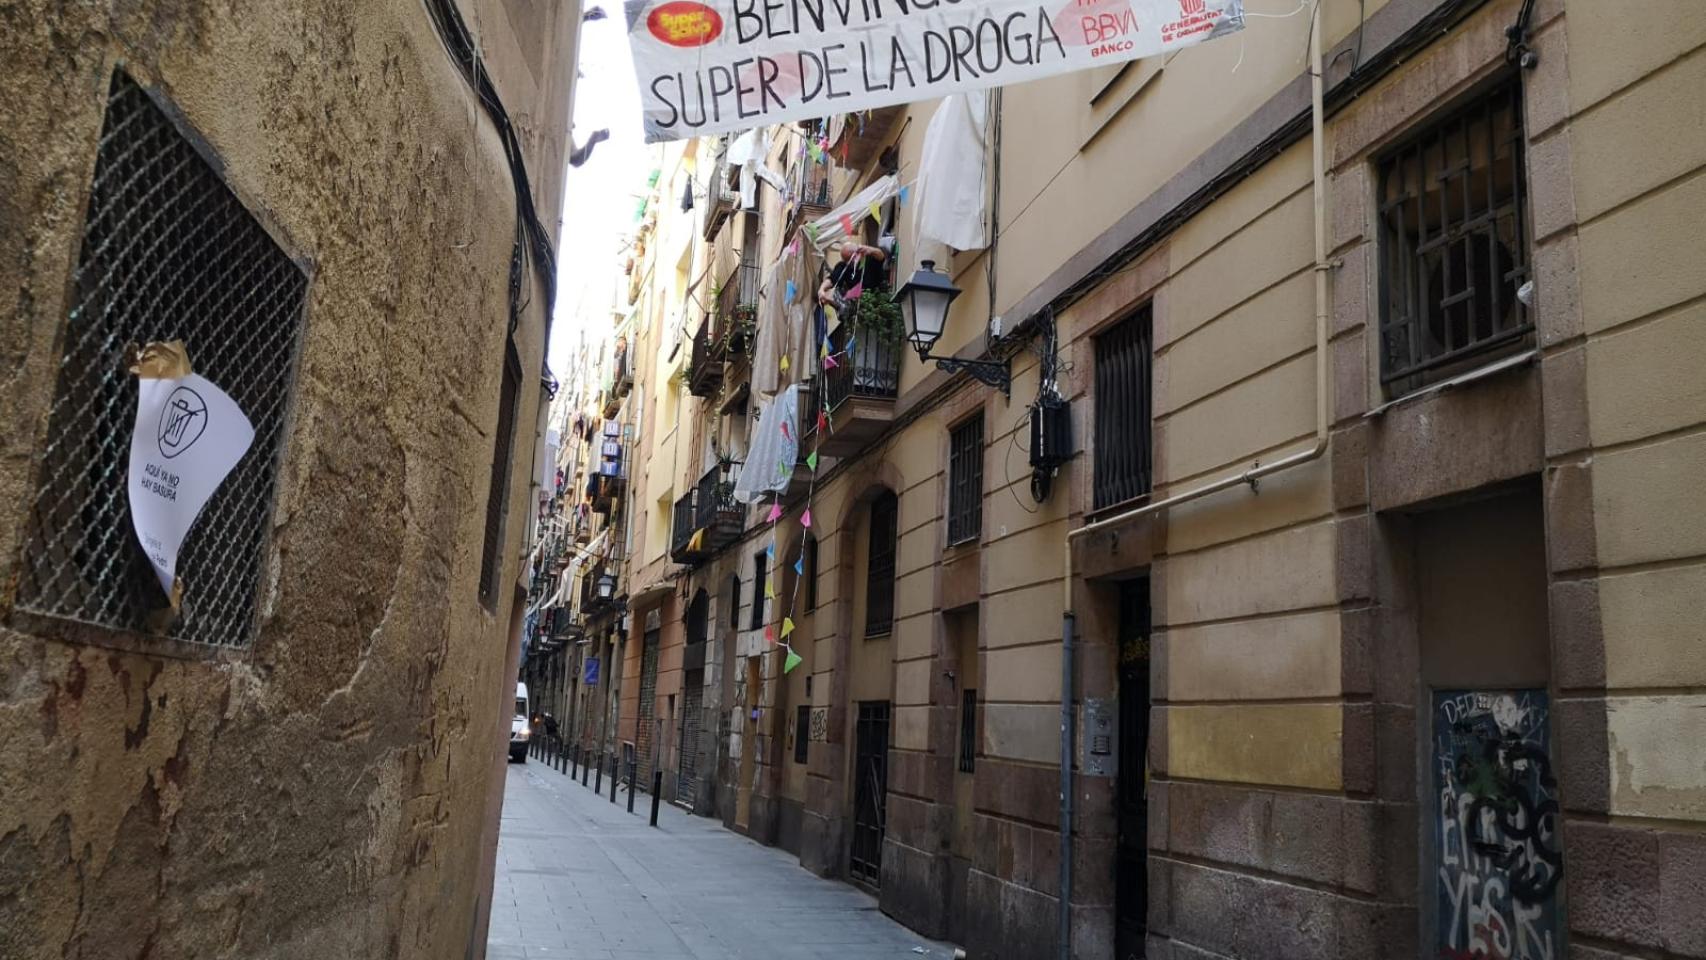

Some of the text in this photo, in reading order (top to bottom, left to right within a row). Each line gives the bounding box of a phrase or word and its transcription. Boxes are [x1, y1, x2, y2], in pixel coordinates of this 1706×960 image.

[651, 7, 1066, 129] SUPER DE LA DROGA
[1091, 41, 1134, 58] BANCO
